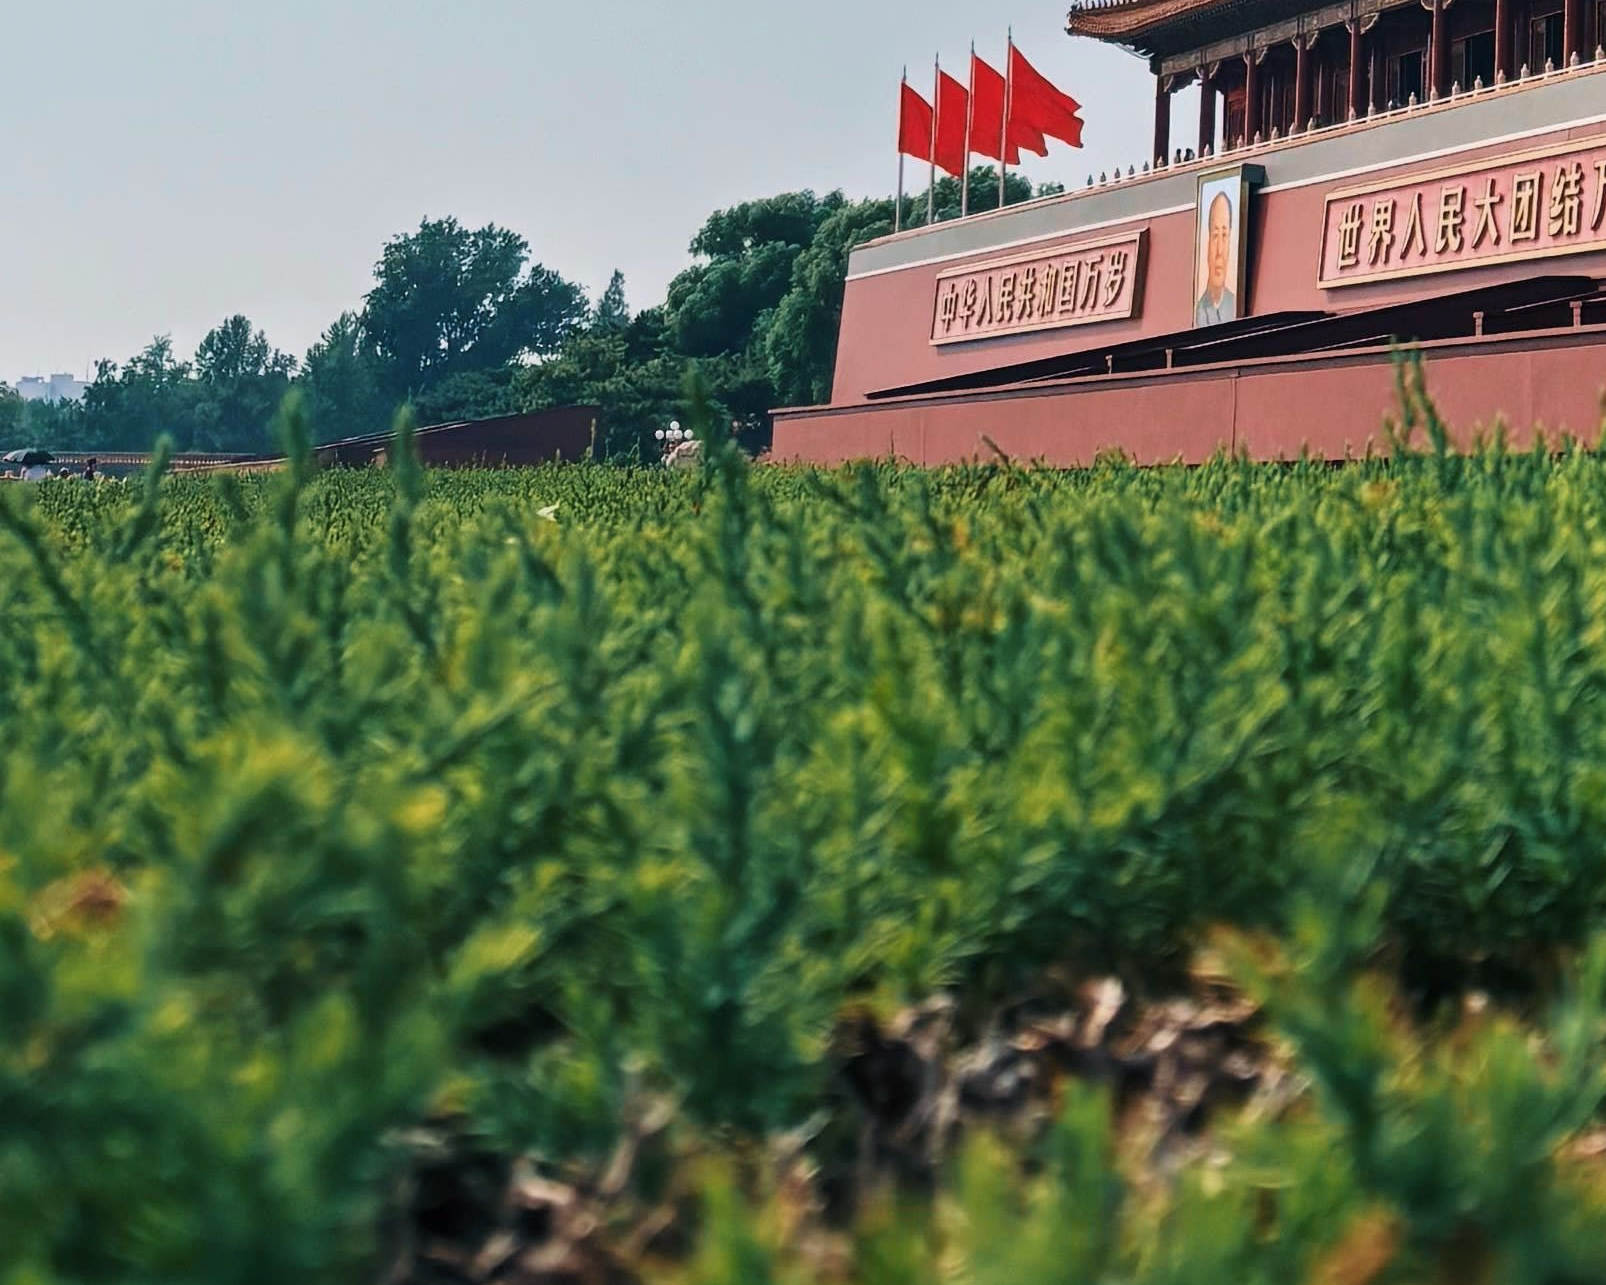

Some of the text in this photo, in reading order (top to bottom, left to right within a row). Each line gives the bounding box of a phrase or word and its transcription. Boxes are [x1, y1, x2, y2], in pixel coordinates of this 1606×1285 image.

[940, 251, 1128, 333] 中华人民共和国万岁
